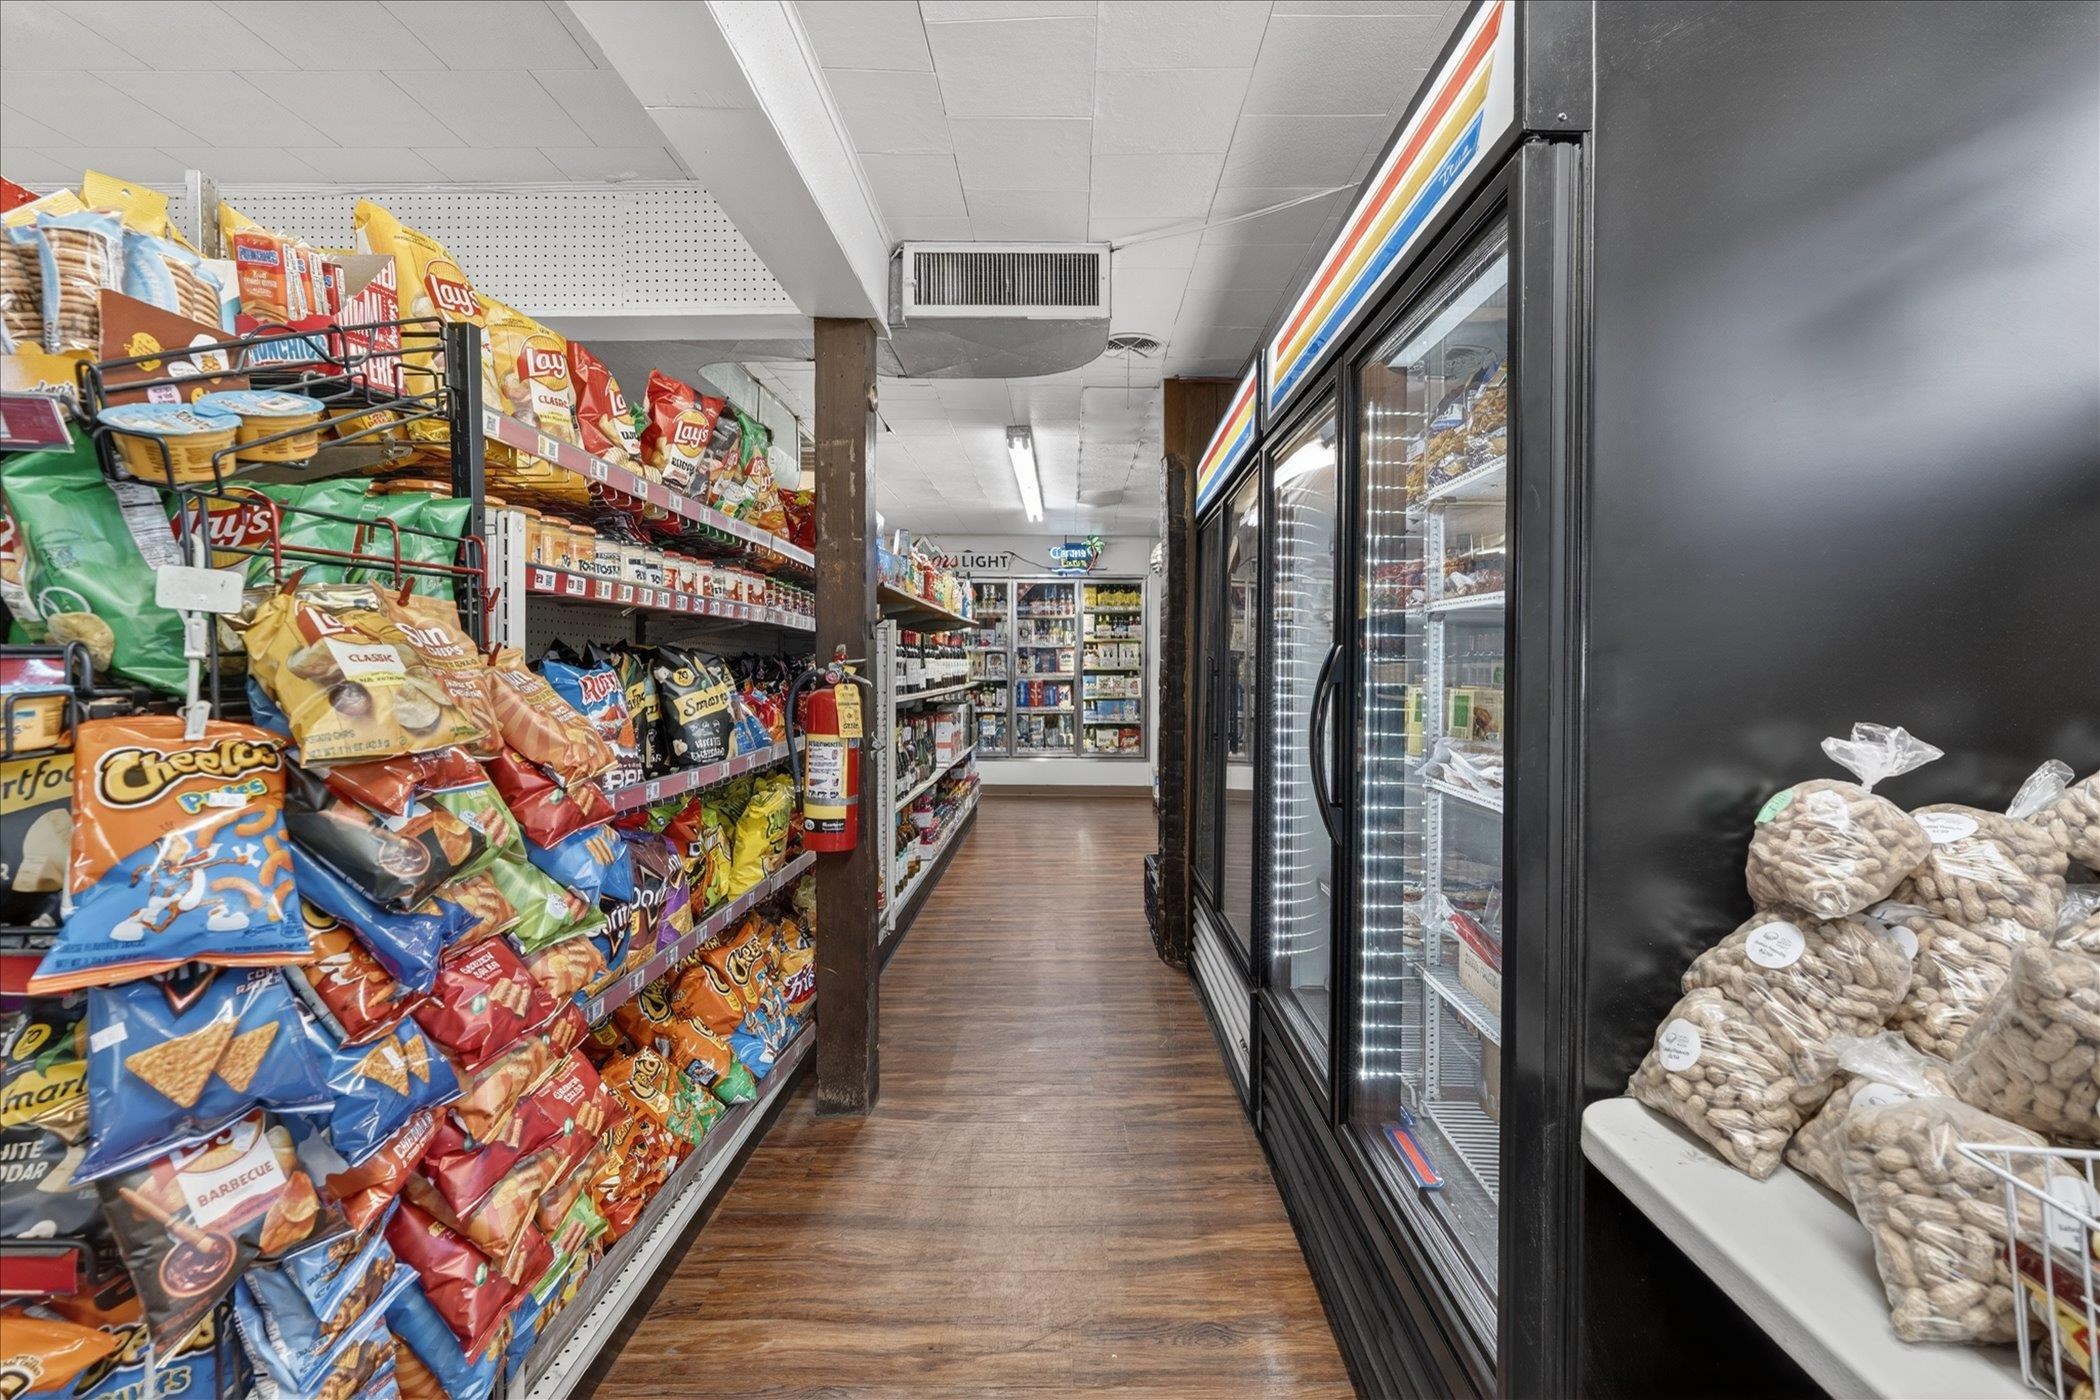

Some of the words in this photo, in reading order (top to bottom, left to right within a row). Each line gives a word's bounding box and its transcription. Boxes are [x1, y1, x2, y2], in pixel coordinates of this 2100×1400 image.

[1050, 547, 1086, 559] Corona
[962, 555, 1008, 568] LIGHT
[347, 653, 395, 664] CLASSIC
[99, 740, 279, 805] Cheetos
[198, 1160, 275, 1208] BARBECUE
